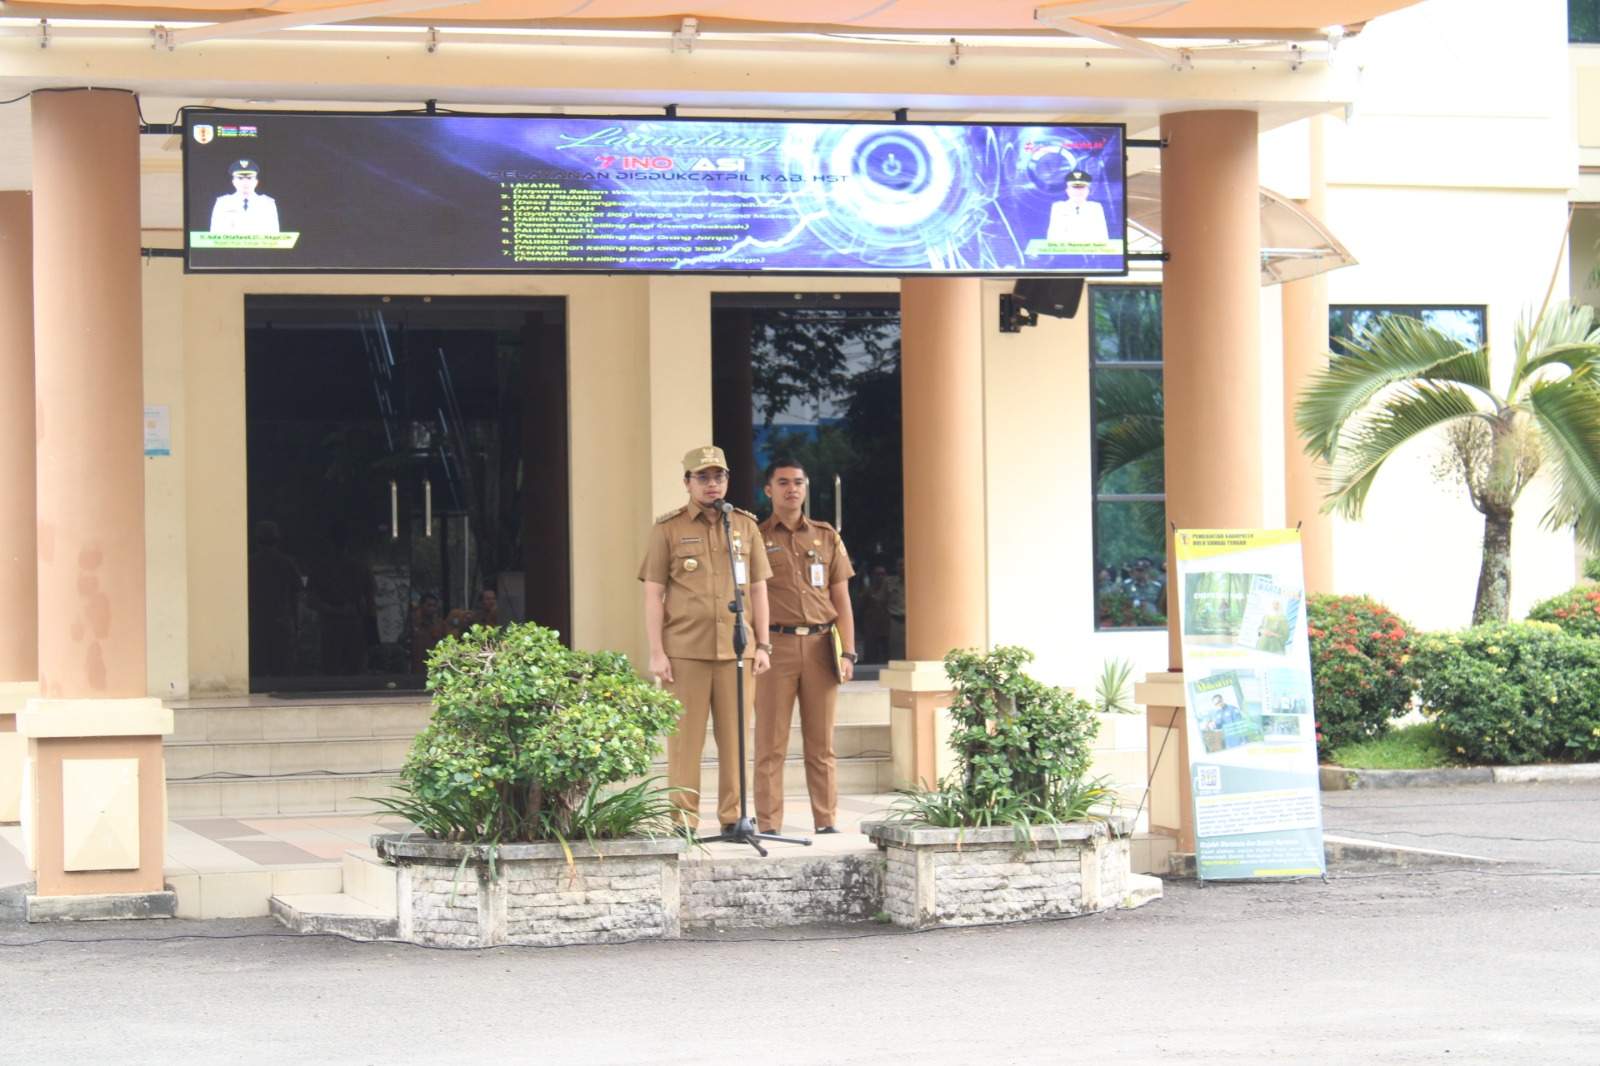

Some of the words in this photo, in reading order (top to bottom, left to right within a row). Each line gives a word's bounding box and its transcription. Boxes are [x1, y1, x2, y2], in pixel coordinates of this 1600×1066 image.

[595, 155, 617, 169] 7
[622, 156, 745, 172] INOVASI
[812, 174, 847, 183] HST
